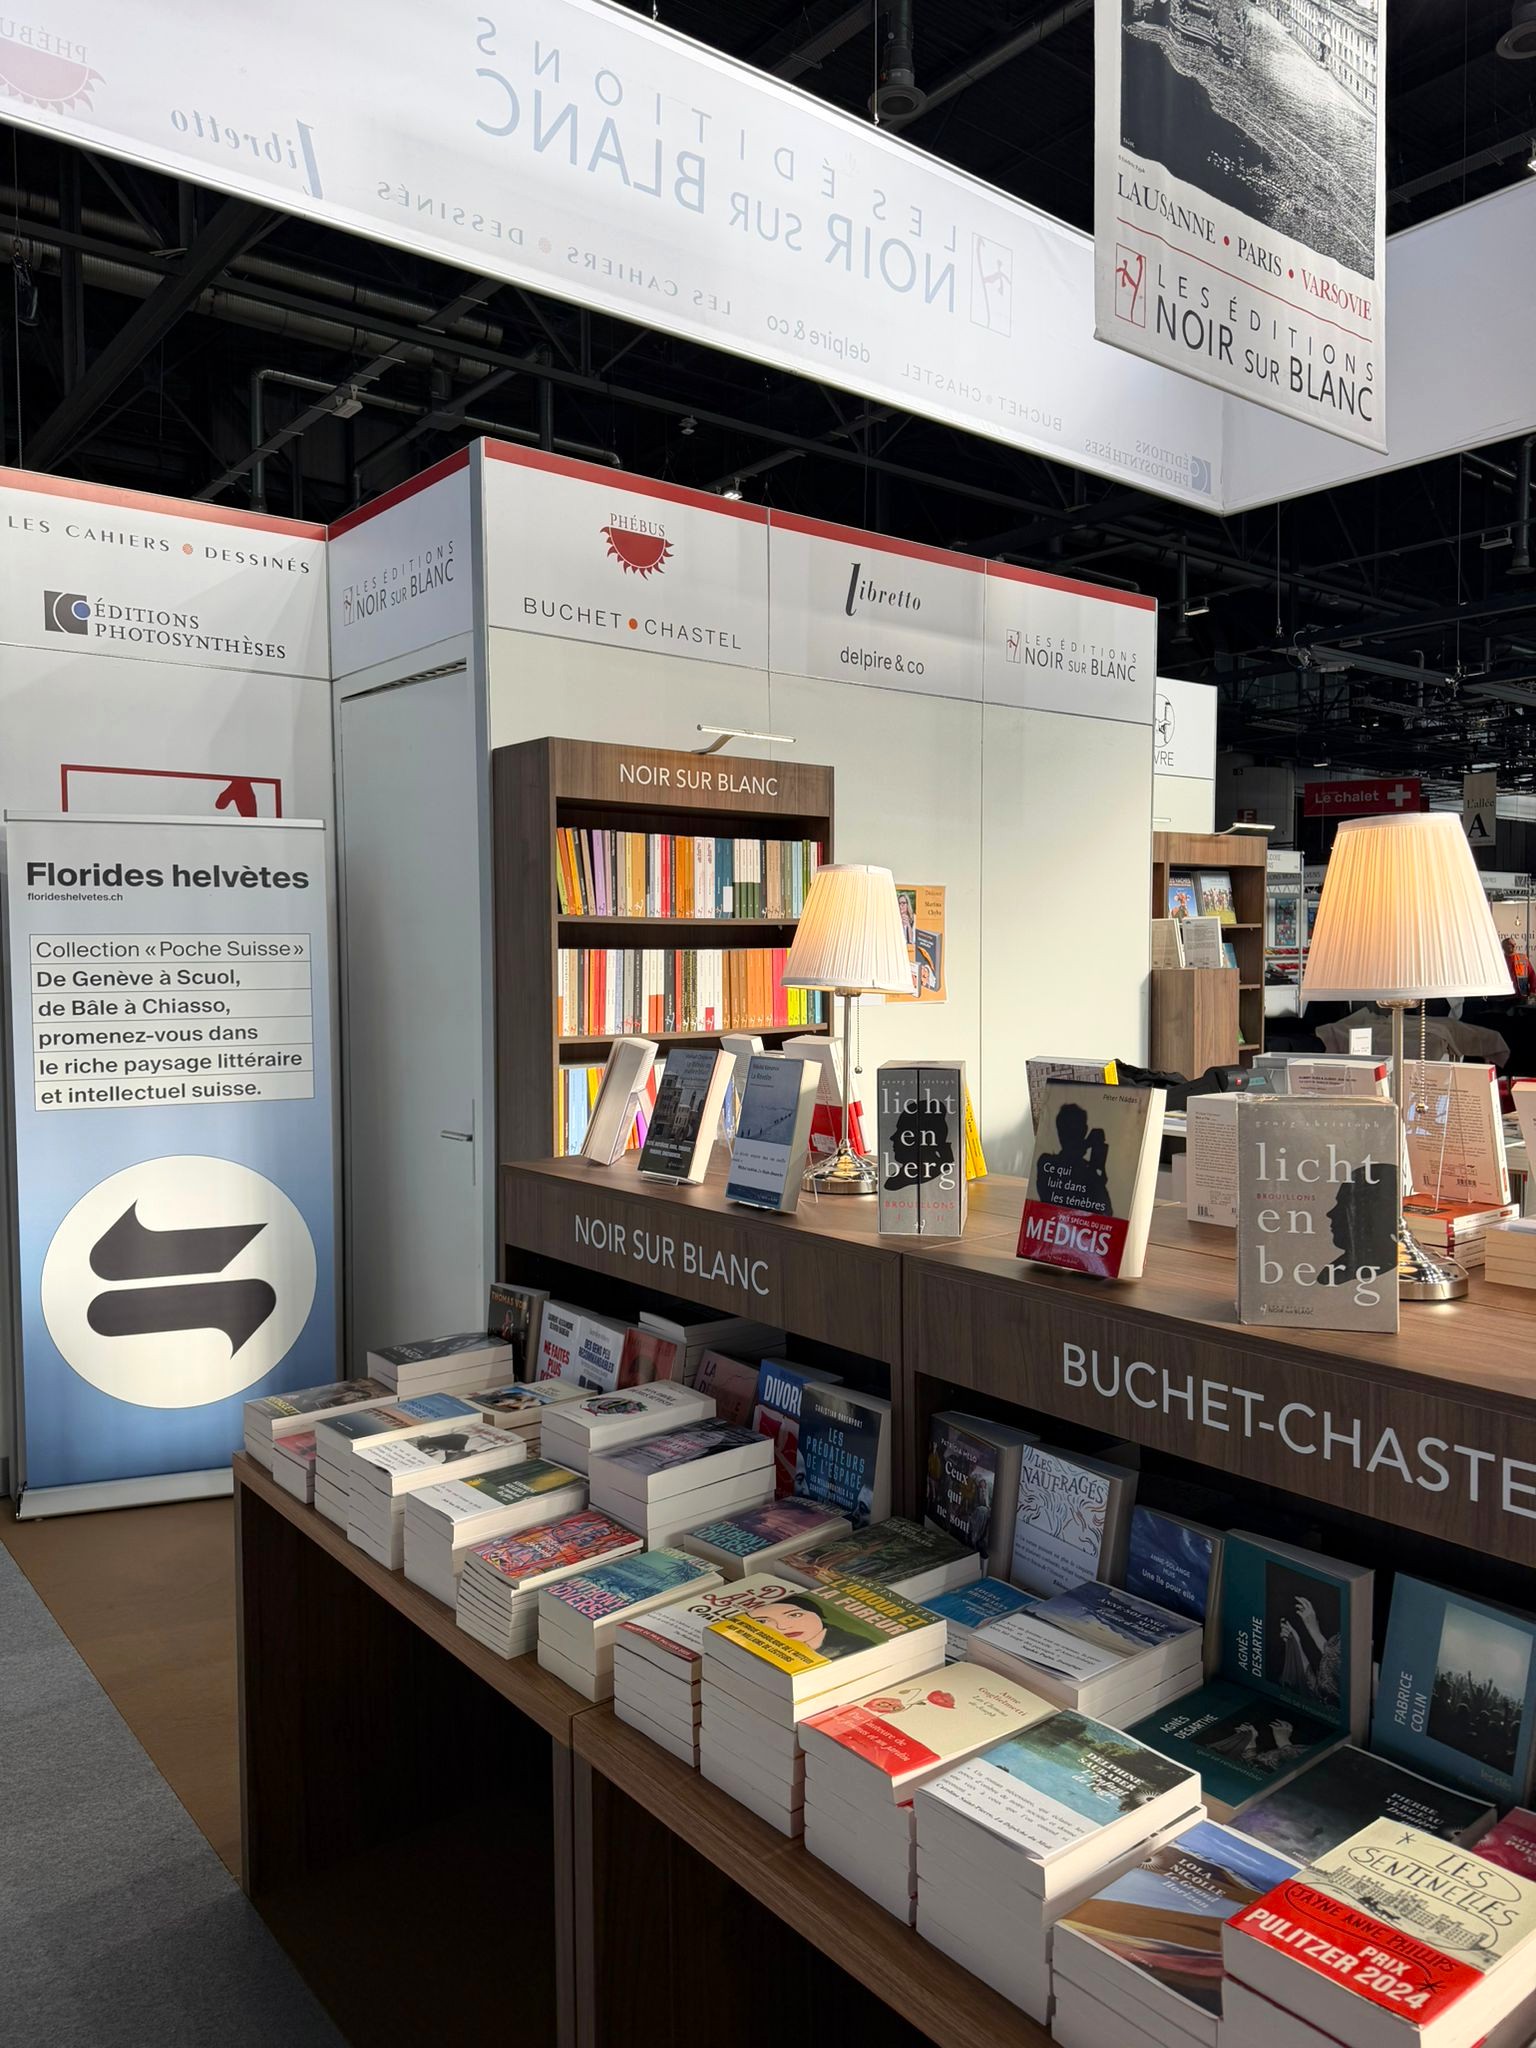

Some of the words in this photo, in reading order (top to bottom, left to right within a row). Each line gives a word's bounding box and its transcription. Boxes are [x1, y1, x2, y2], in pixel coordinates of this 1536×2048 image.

[1118, 173, 1216, 245] LAUSANNE
[1238, 236, 1282, 277] PARIS
[1301, 269, 1373, 321] VARSOVIE
[1159, 264, 1210, 309] LES
[1229, 296, 1374, 382] ÉDITIONS
[1156, 295, 1234, 365] NOIR
[1245, 349, 1280, 385] SUR
[1290, 356, 1373, 422] BLANC
[610, 512, 666, 538] PHÉBUS
[8, 515, 51, 534] LES
[65, 525, 170, 553] CAHIERS
[205, 546, 311, 575] DESSINÉS
[356, 588, 388, 620] NOIR
[390, 586, 408, 607] SUR
[410, 558, 455, 598] BLANC
[845, 562, 922, 616] libretto
[94, 598, 200, 630] ÉDITIONS
[95, 622, 287, 660] PHOTOSYNTHÈSES
[1024, 646, 1064, 670] NOIR
[1068, 660, 1087, 674] SUR
[1091, 659, 1137, 682] BLANC
[1153, 749, 1175, 767] VRE
[619, 763, 670, 787] NOIR
[676, 768, 712, 790] SUR
[718, 772, 779, 796] BLANC
[1315, 792, 1333, 804] Le
[1335, 790, 1380, 803] chalet
[1468, 813, 1490, 837] A
[27, 862, 164, 887] Florides
[172, 864, 310, 889] helvètes
[27, 892, 124, 902] florideshelvetes.ch
[36, 941, 140, 958] Collection
[36, 971, 66, 987] De
[72, 969, 154, 987] Genève
[160, 970, 172, 985] à
[177, 969, 241, 987] Scuol,
[38, 1000, 66, 1017] de
[72, 998, 119, 1016] Bâle
[125, 999, 137, 1015] à
[143, 997, 231, 1015] Chiasso,
[39, 1028, 203, 1049] promenez-vous
[208, 1025, 259, 1041] dans
[39, 1059, 59, 1075] le
[65, 1057, 118, 1074] riche
[124, 1055, 212, 1076] paysage
[218, 1051, 303, 1069] littéraire
[41, 1089, 63, 1104] et
[68, 1083, 186, 1103] intellectuel
[191, 1081, 262, 1098] suisse.
[882, 1088, 956, 1115] licht
[900, 1129, 938, 1147] en
[884, 1152, 956, 1191] berg
[1043, 1162, 1055, 1174] Ce
[1057, 1165, 1073, 1177] qui
[1256, 1143, 1381, 1185] licht
[1048, 1176, 1063, 1188] luit
[1064, 1179, 1087, 1193] dans
[1256, 1193, 1316, 1201] BROUILLONS
[1051, 1191, 1064, 1204] les
[1065, 1193, 1106, 1211] ténèbres
[1026, 1216, 1111, 1256] MÉDICIS
[1257, 1209, 1316, 1235] en
[575, 1215, 626, 1256] NOIR
[633, 1228, 676, 1268] SUR
[683, 1242, 770, 1296] BLANC
[1256, 1246, 1381, 1307] berg
[547, 1358, 562, 1377] PLUS
[552, 1342, 570, 1365] FAITES
[828, 1427, 844, 1446] LES
[1063, 1342, 1536, 1520] BUCHET-CHASTE
[806, 1436, 865, 1473] PRÉDATEURS
[1034, 1454, 1052, 1472] LES
[806, 1453, 817, 1470] DE
[820, 1459, 861, 1489] L'ESPACE
[944, 1460, 969, 1486] Ceux
[1022, 1466, 1105, 1504] NAUFRAGÉS
[947, 1488, 962, 1505] qui
[936, 1504, 949, 1518] ne
[950, 1510, 971, 1534] sont
[565, 1577, 628, 1609] ANTHONY
[1142, 1568, 1155, 1582] Une
[1165, 1581, 1182, 1596] pour
[1182, 1588, 1195, 1601] elle
[546, 1585, 611, 1620] ADVERSE
[810, 1586, 841, 1600] LA
[834, 1597, 908, 1635] FUREUR
[830, 1579, 906, 1617] L'AMOUR
[898, 1614, 928, 1628] ET
[1236, 1630, 1249, 1670] AGNÈS
[1251, 1616, 1263, 1677] DESARTHE
[1394, 1671, 1413, 1725] FABRICE
[1410, 1692, 1428, 1733] COLIN
[1160, 1715, 1190, 1734] AGNÈS
[1174, 1714, 1219, 1740] DESARTHE
[895, 1736, 907, 1747] de
[1071, 1773, 1088, 1784] de
[1081, 1769, 1130, 1796] L'Enfant
[1087, 1752, 1144, 1785] DELPHINE
[1391, 1793, 1437, 1816] PIERRE
[1169, 1864, 1226, 1897] NICOLLE
[1179, 1859, 1212, 1880] LOLA
[1436, 1855, 1495, 1889] LES
[1162, 1880, 1209, 1909] Horizon
[1164, 1871, 1180, 1881] Le
[1180, 1880, 1219, 1903] Grand
[1354, 1848, 1520, 1926] SENTINELLES
[1290, 1887, 1342, 1916] JAYNE
[1345, 1913, 1386, 1941] ANNE
[1389, 1931, 1459, 1973] PHILLIPS
[1244, 1908, 1359, 1973] PULITZER
[1354, 1966, 1432, 2010] 2024
[1358, 1946, 1411, 1977] PRIX
